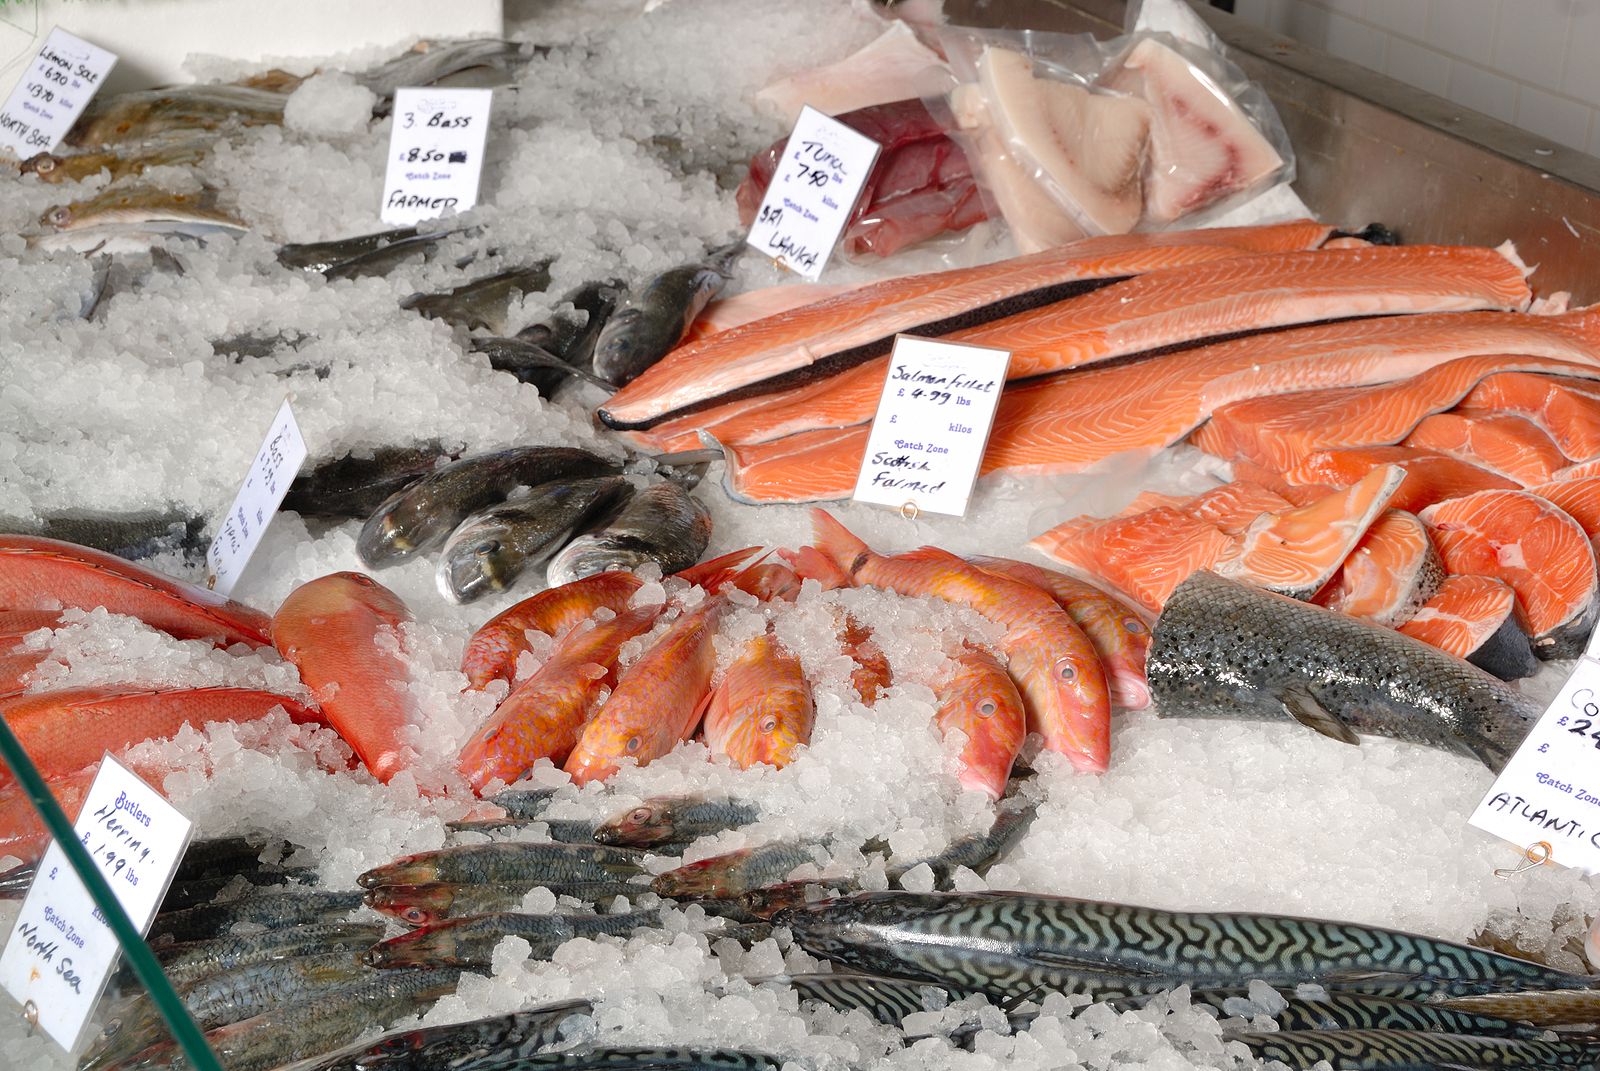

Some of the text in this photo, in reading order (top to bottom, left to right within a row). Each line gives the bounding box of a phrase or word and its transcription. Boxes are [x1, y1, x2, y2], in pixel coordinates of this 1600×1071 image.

[427, 112, 472, 128] Bass
[768, 231, 819, 272] LANKA
[897, 387, 905, 398] £
[956, 396, 972, 407] lbs
[890, 414, 973, 434] £ kilos
[894, 439, 949, 455] Catch Zone
[1537, 743, 1550, 753] £
[1536, 772, 1600, 807] Catch Zon
[115, 790, 151, 828] Butlers
[81, 831, 90, 846] £
[125, 867, 139, 887] lbs
[49, 867, 58, 881] £
[44, 905, 85, 949] Catch Zone
[18, 921, 82, 995] North Sea
